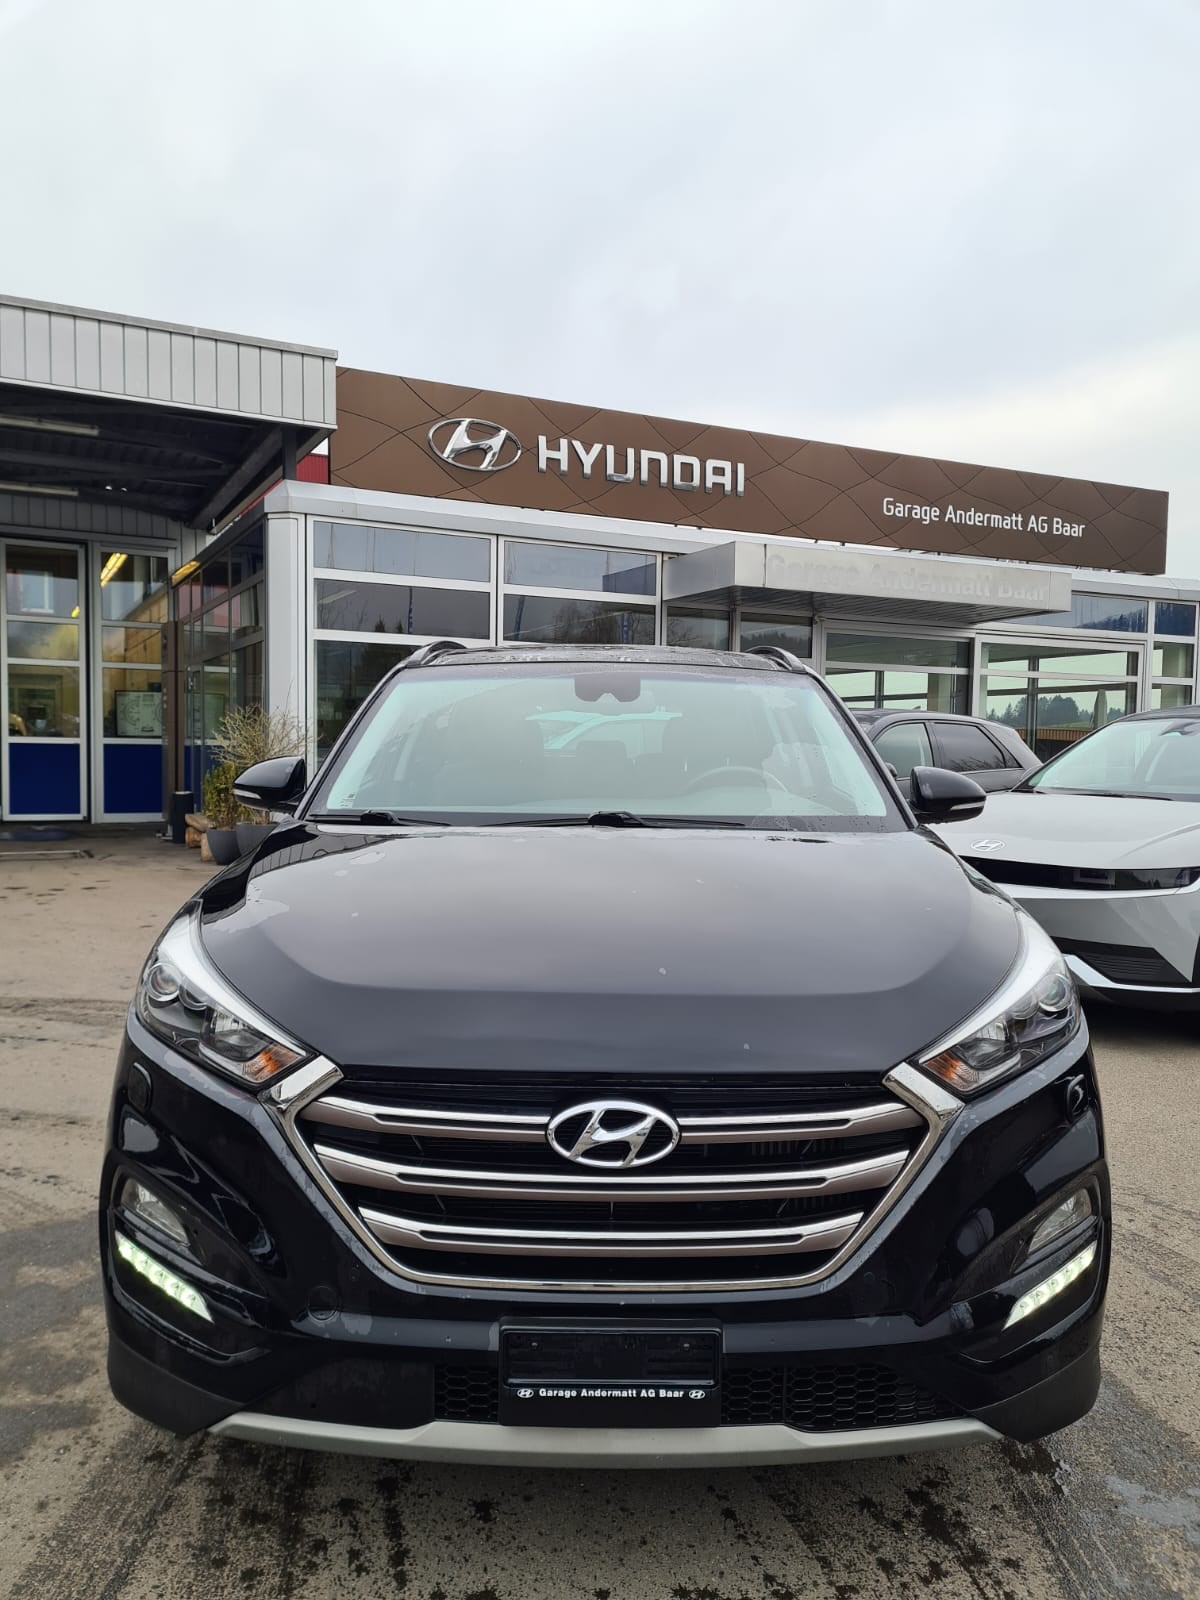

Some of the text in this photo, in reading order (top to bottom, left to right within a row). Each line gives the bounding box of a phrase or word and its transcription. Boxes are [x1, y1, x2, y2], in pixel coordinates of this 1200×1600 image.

[538, 435, 745, 497] HYUNDAI
[882, 497, 1086, 538] Garage Andermatt AG Baar
[539, 1388, 685, 1399] Garage Andermatt AG Baar
